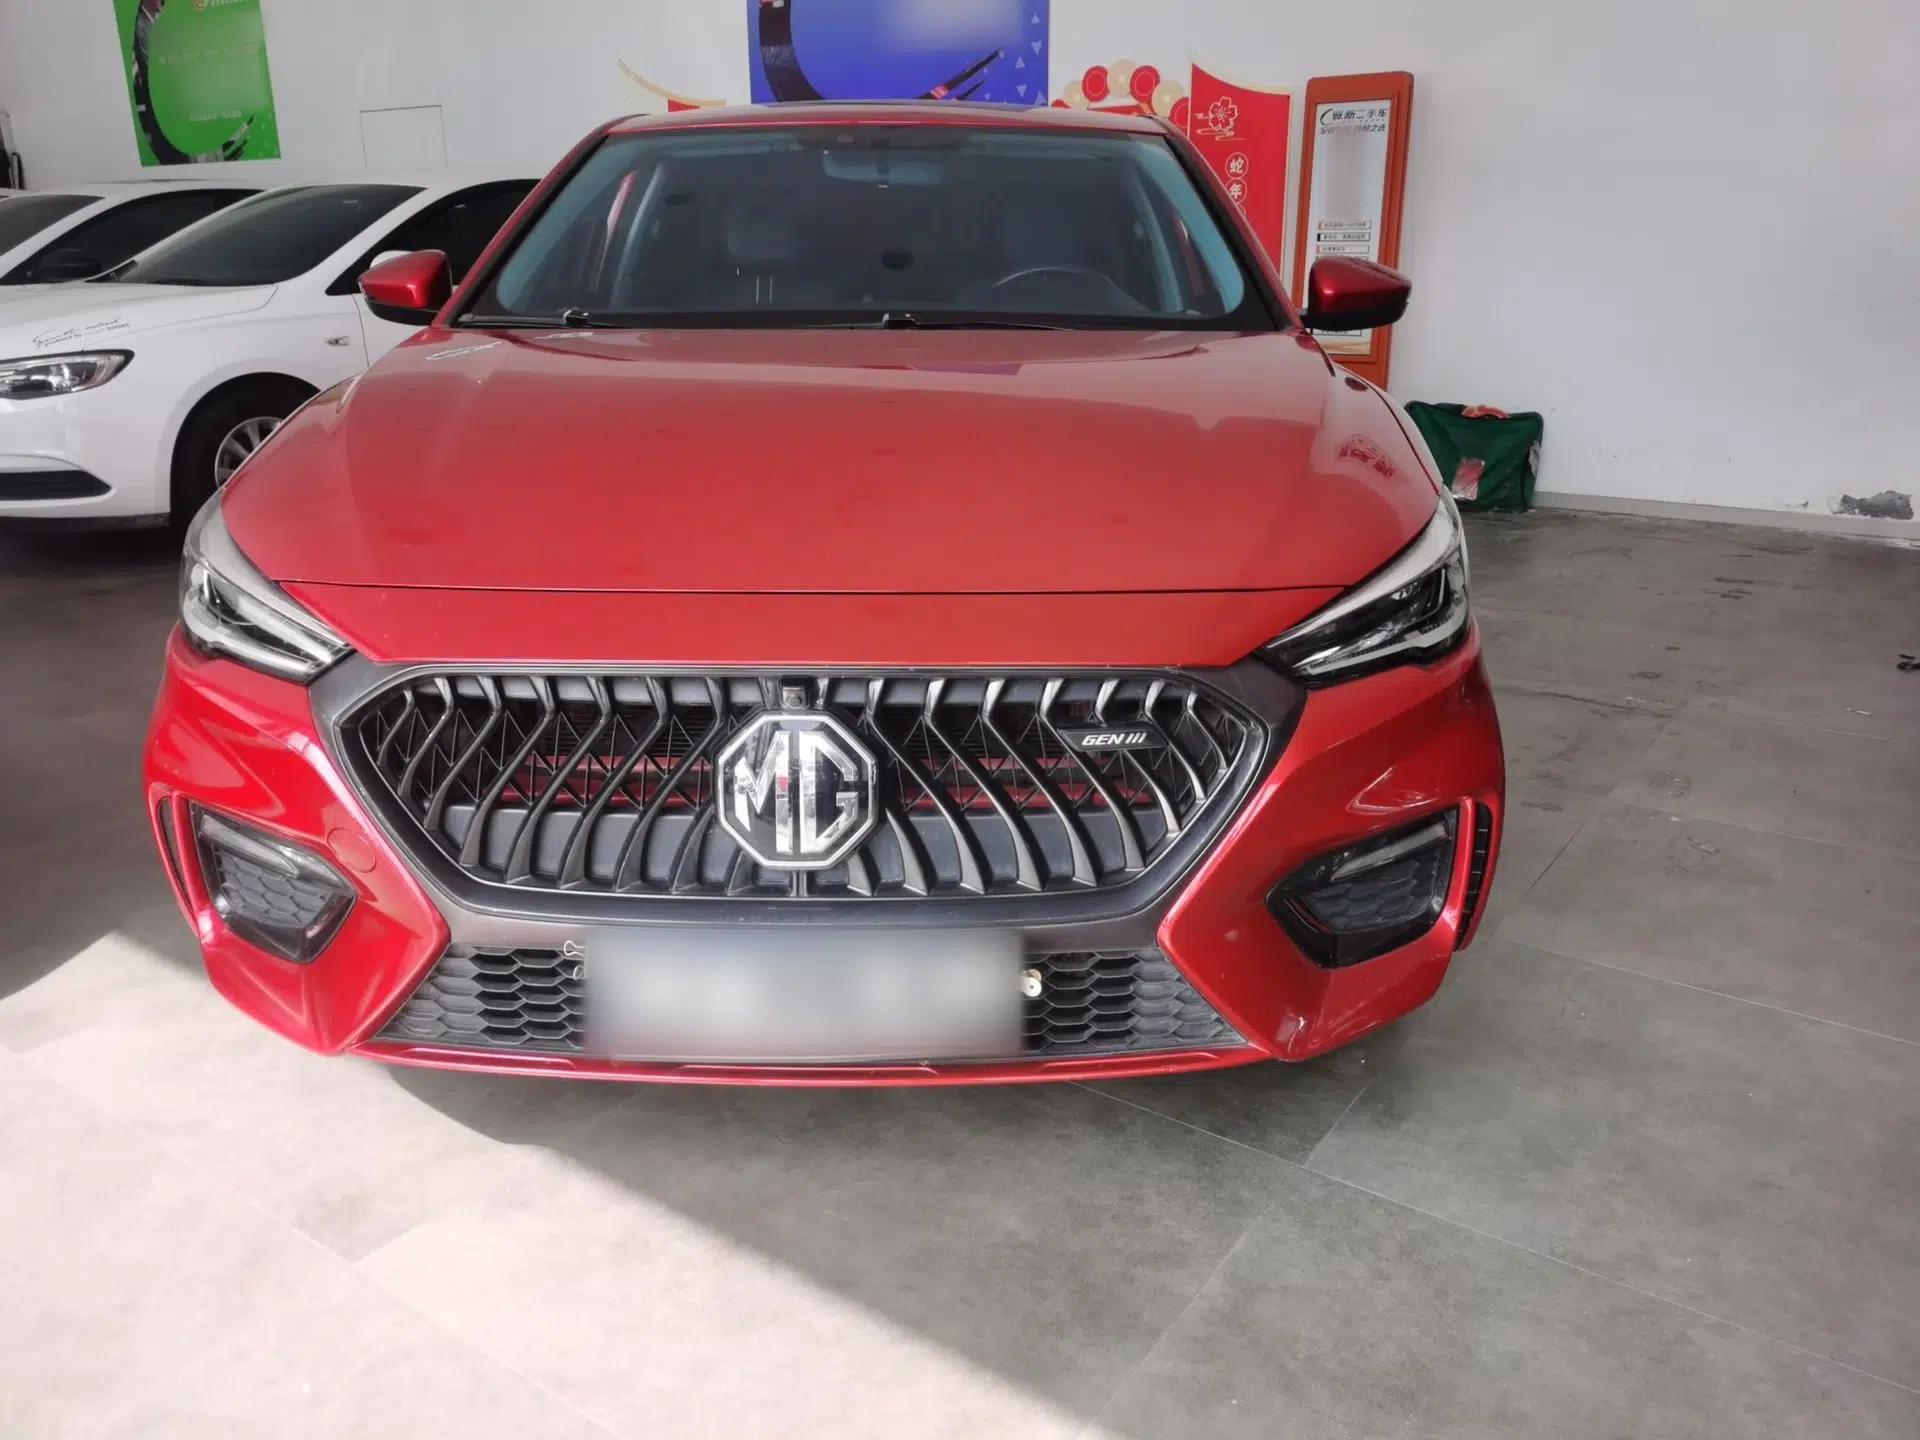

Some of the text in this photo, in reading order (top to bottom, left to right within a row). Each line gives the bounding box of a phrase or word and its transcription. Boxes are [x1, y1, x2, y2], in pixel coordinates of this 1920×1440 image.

[1081, 732, 1147, 746] GEN III
[734, 731, 859, 854] MG
